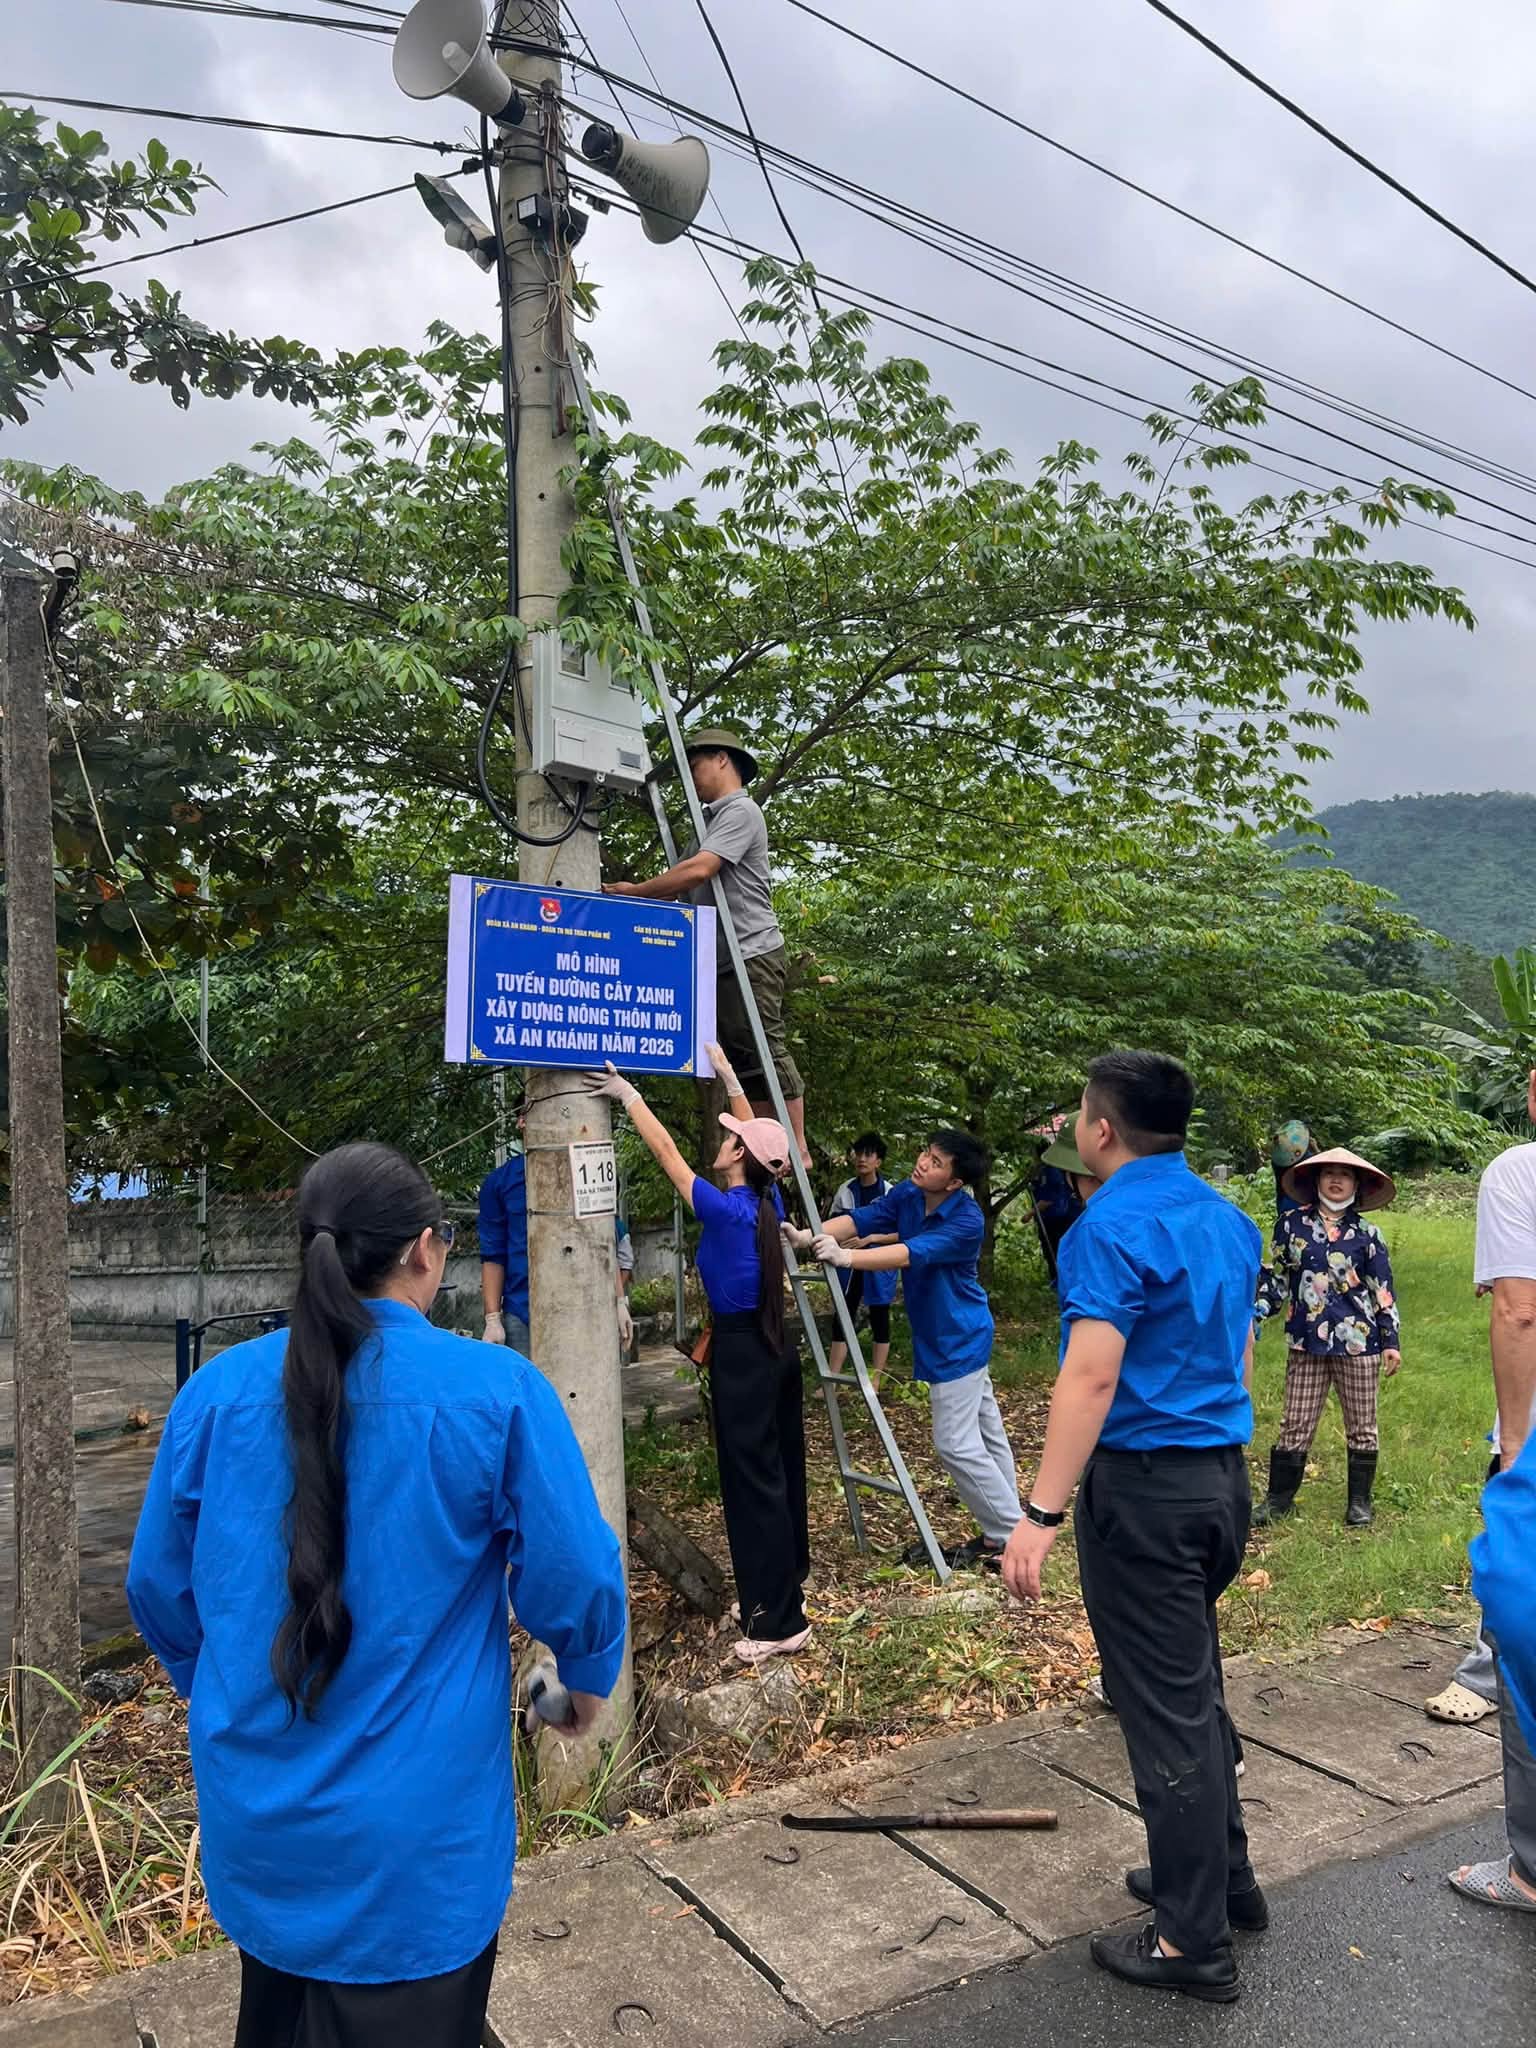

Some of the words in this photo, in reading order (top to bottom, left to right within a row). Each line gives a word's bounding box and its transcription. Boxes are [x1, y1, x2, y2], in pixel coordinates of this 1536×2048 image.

[556, 951, 580, 972] MÔ
[584, 953, 620, 976] HÌNH
[495, 970, 545, 995] TUYẾN
[549, 976, 600, 1000] ĐƯỜNG
[604, 980, 633, 1002] CÂY
[636, 985, 675, 1006] XANH
[486, 995, 518, 1019] XÂY
[521, 1001, 564, 1025] DỰNG
[567, 1003, 610, 1026] NÔNG
[613, 1007, 651, 1029] THÔN
[654, 1010, 682, 1032] MỚI
[494, 1023, 517, 1045] XÃ
[519, 1028, 543, 1047] AN
[546, 1028, 598, 1051] KHÁNH
[601, 1031, 636, 1054] NĂM
[639, 1036, 674, 1056] 2026
[579, 1161, 613, 1184] 1.18
